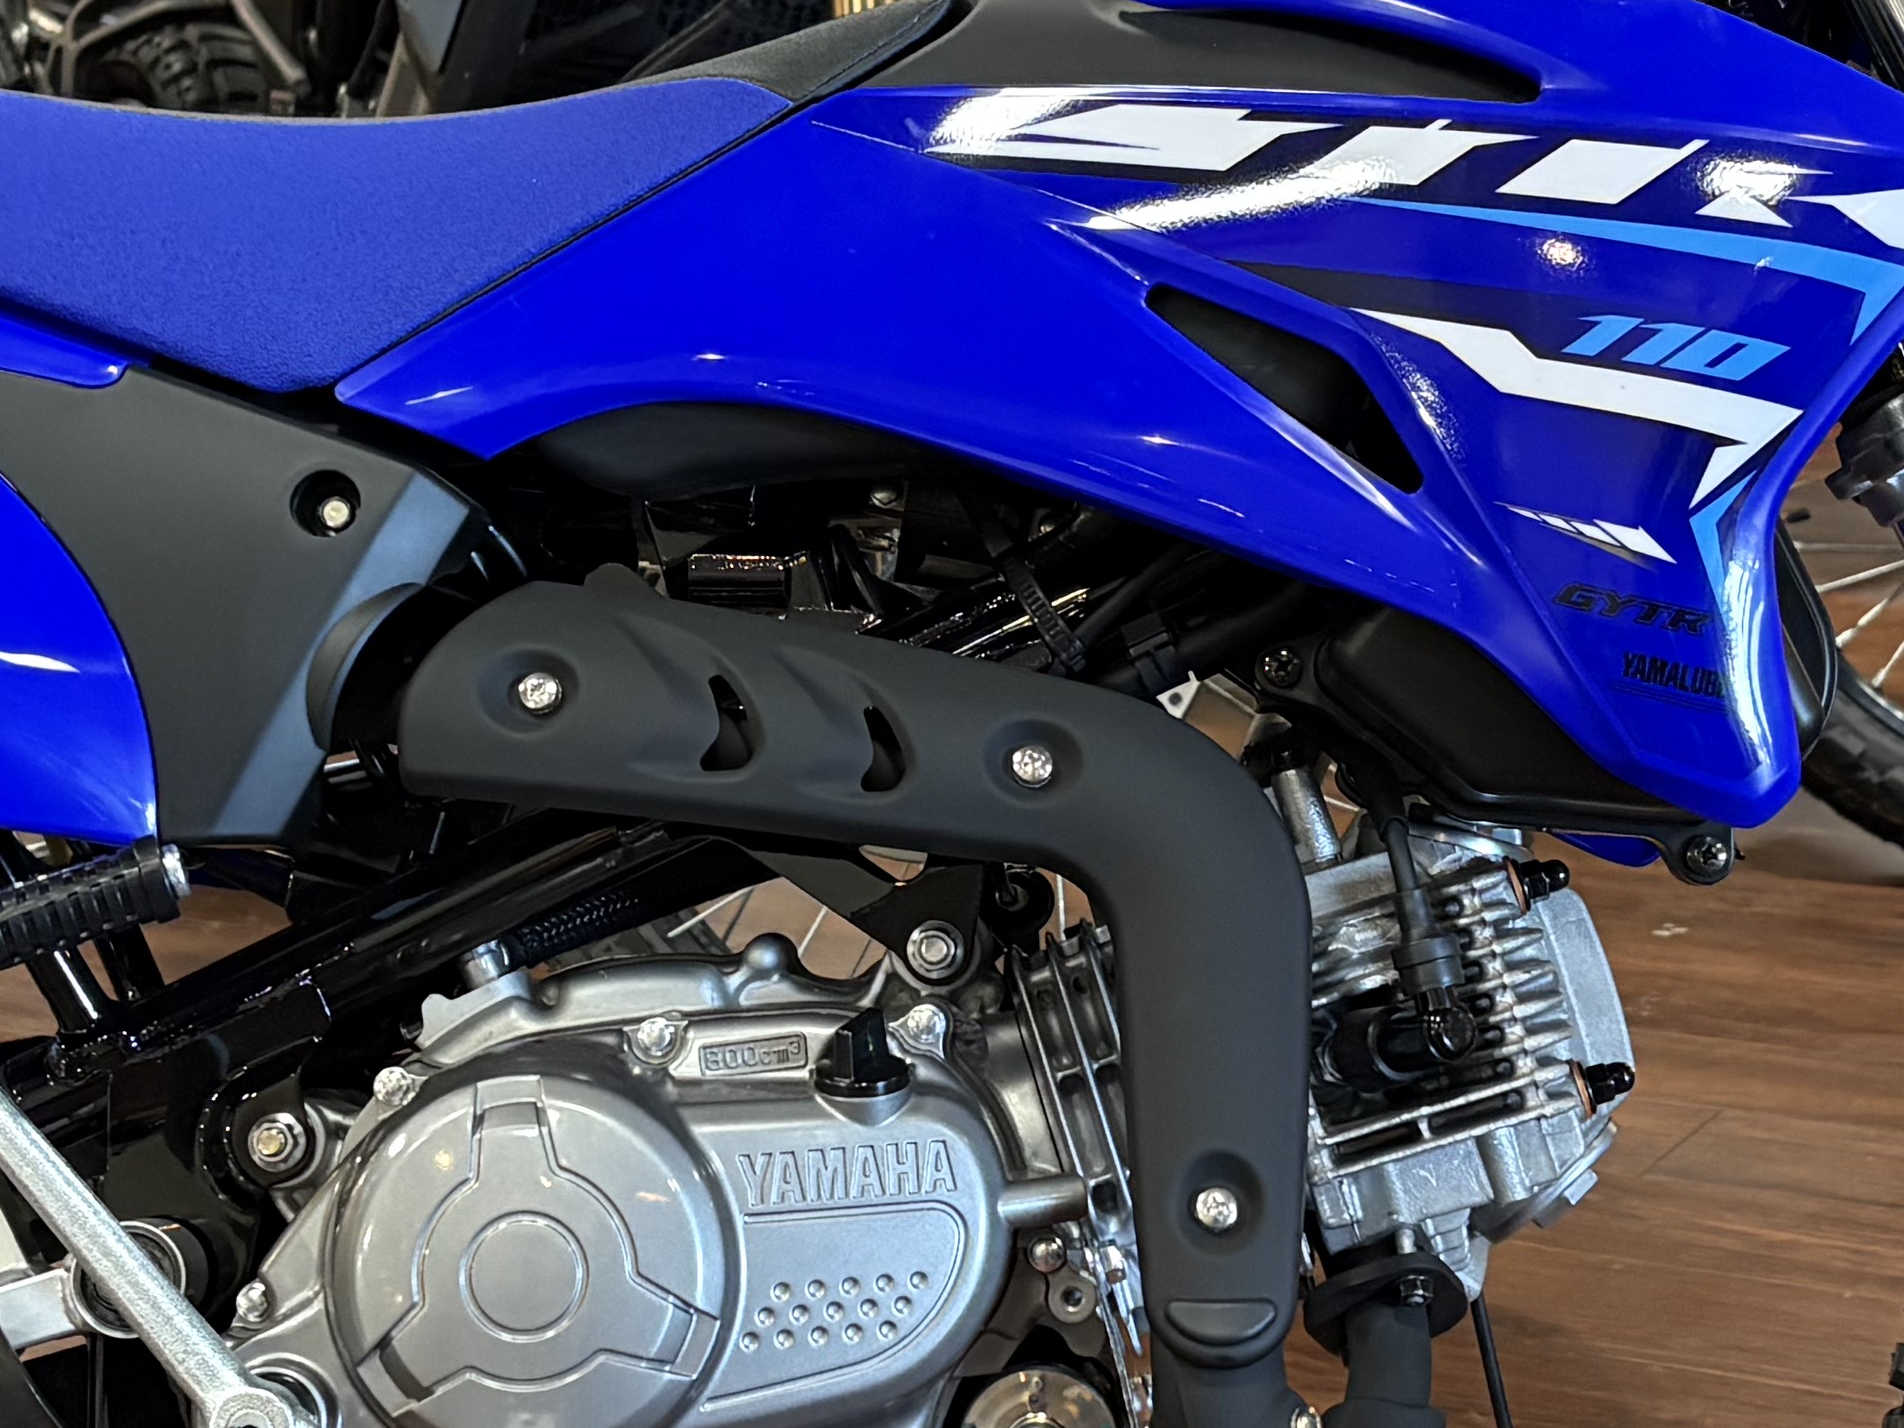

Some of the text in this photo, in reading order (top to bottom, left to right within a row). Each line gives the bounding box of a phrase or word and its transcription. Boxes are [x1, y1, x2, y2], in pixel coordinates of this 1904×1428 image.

[1560, 314, 1789, 382] 110
[1552, 581, 1713, 636] GYTR
[737, 1139, 957, 1208] YAMAHA
